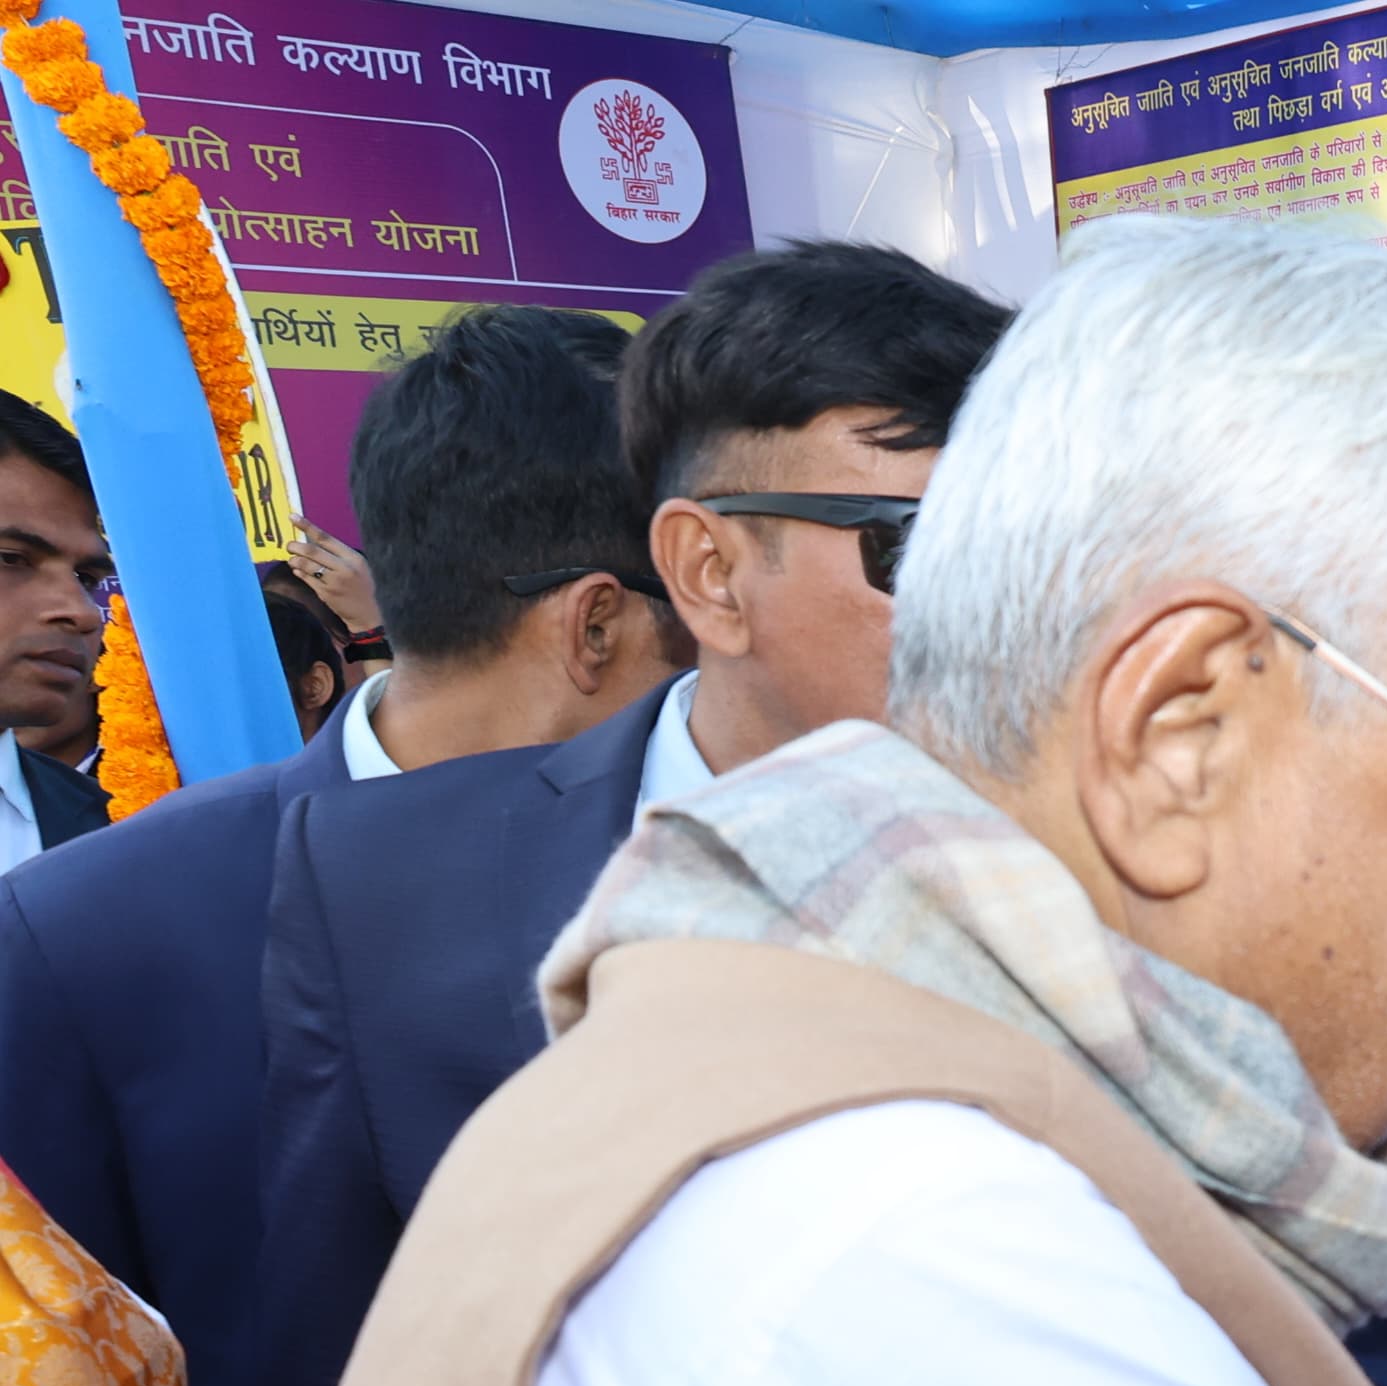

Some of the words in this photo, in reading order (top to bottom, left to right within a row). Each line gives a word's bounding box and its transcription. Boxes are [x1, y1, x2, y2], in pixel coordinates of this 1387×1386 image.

[120, 13, 255, 66] नजाति
[277, 35, 423, 84] कल्याण
[443, 42, 552, 99] विभाग
[1071, 92, 1130, 134] अनुसूचित
[1180, 70, 1201, 106] एवं
[1208, 59, 1271, 104] अनुसूचित
[1279, 41, 1340, 80] जनजाति
[1232, 106, 1261, 131] तथा
[1268, 93, 1313, 126] पिछड़ा
[1320, 79, 1344, 113] वर्ग
[1351, 72, 1373, 111] एवं
[249, 135, 302, 182] एवं
[1163, 170, 1186, 191] जाति
[1210, 157, 1256, 184] अनुसूचित
[1262, 146, 1304, 170] जनजाति
[1310, 142, 1320, 161] के
[1372, 130, 1382, 148] से
[1234, 180, 1259, 201] उनके
[1311, 166, 1346, 187] विकास
[1352, 160, 1366, 179] की
[1345, 188, 1363, 205] रूप
[1370, 182, 1381, 200] से
[371, 210, 480, 255] योजना
